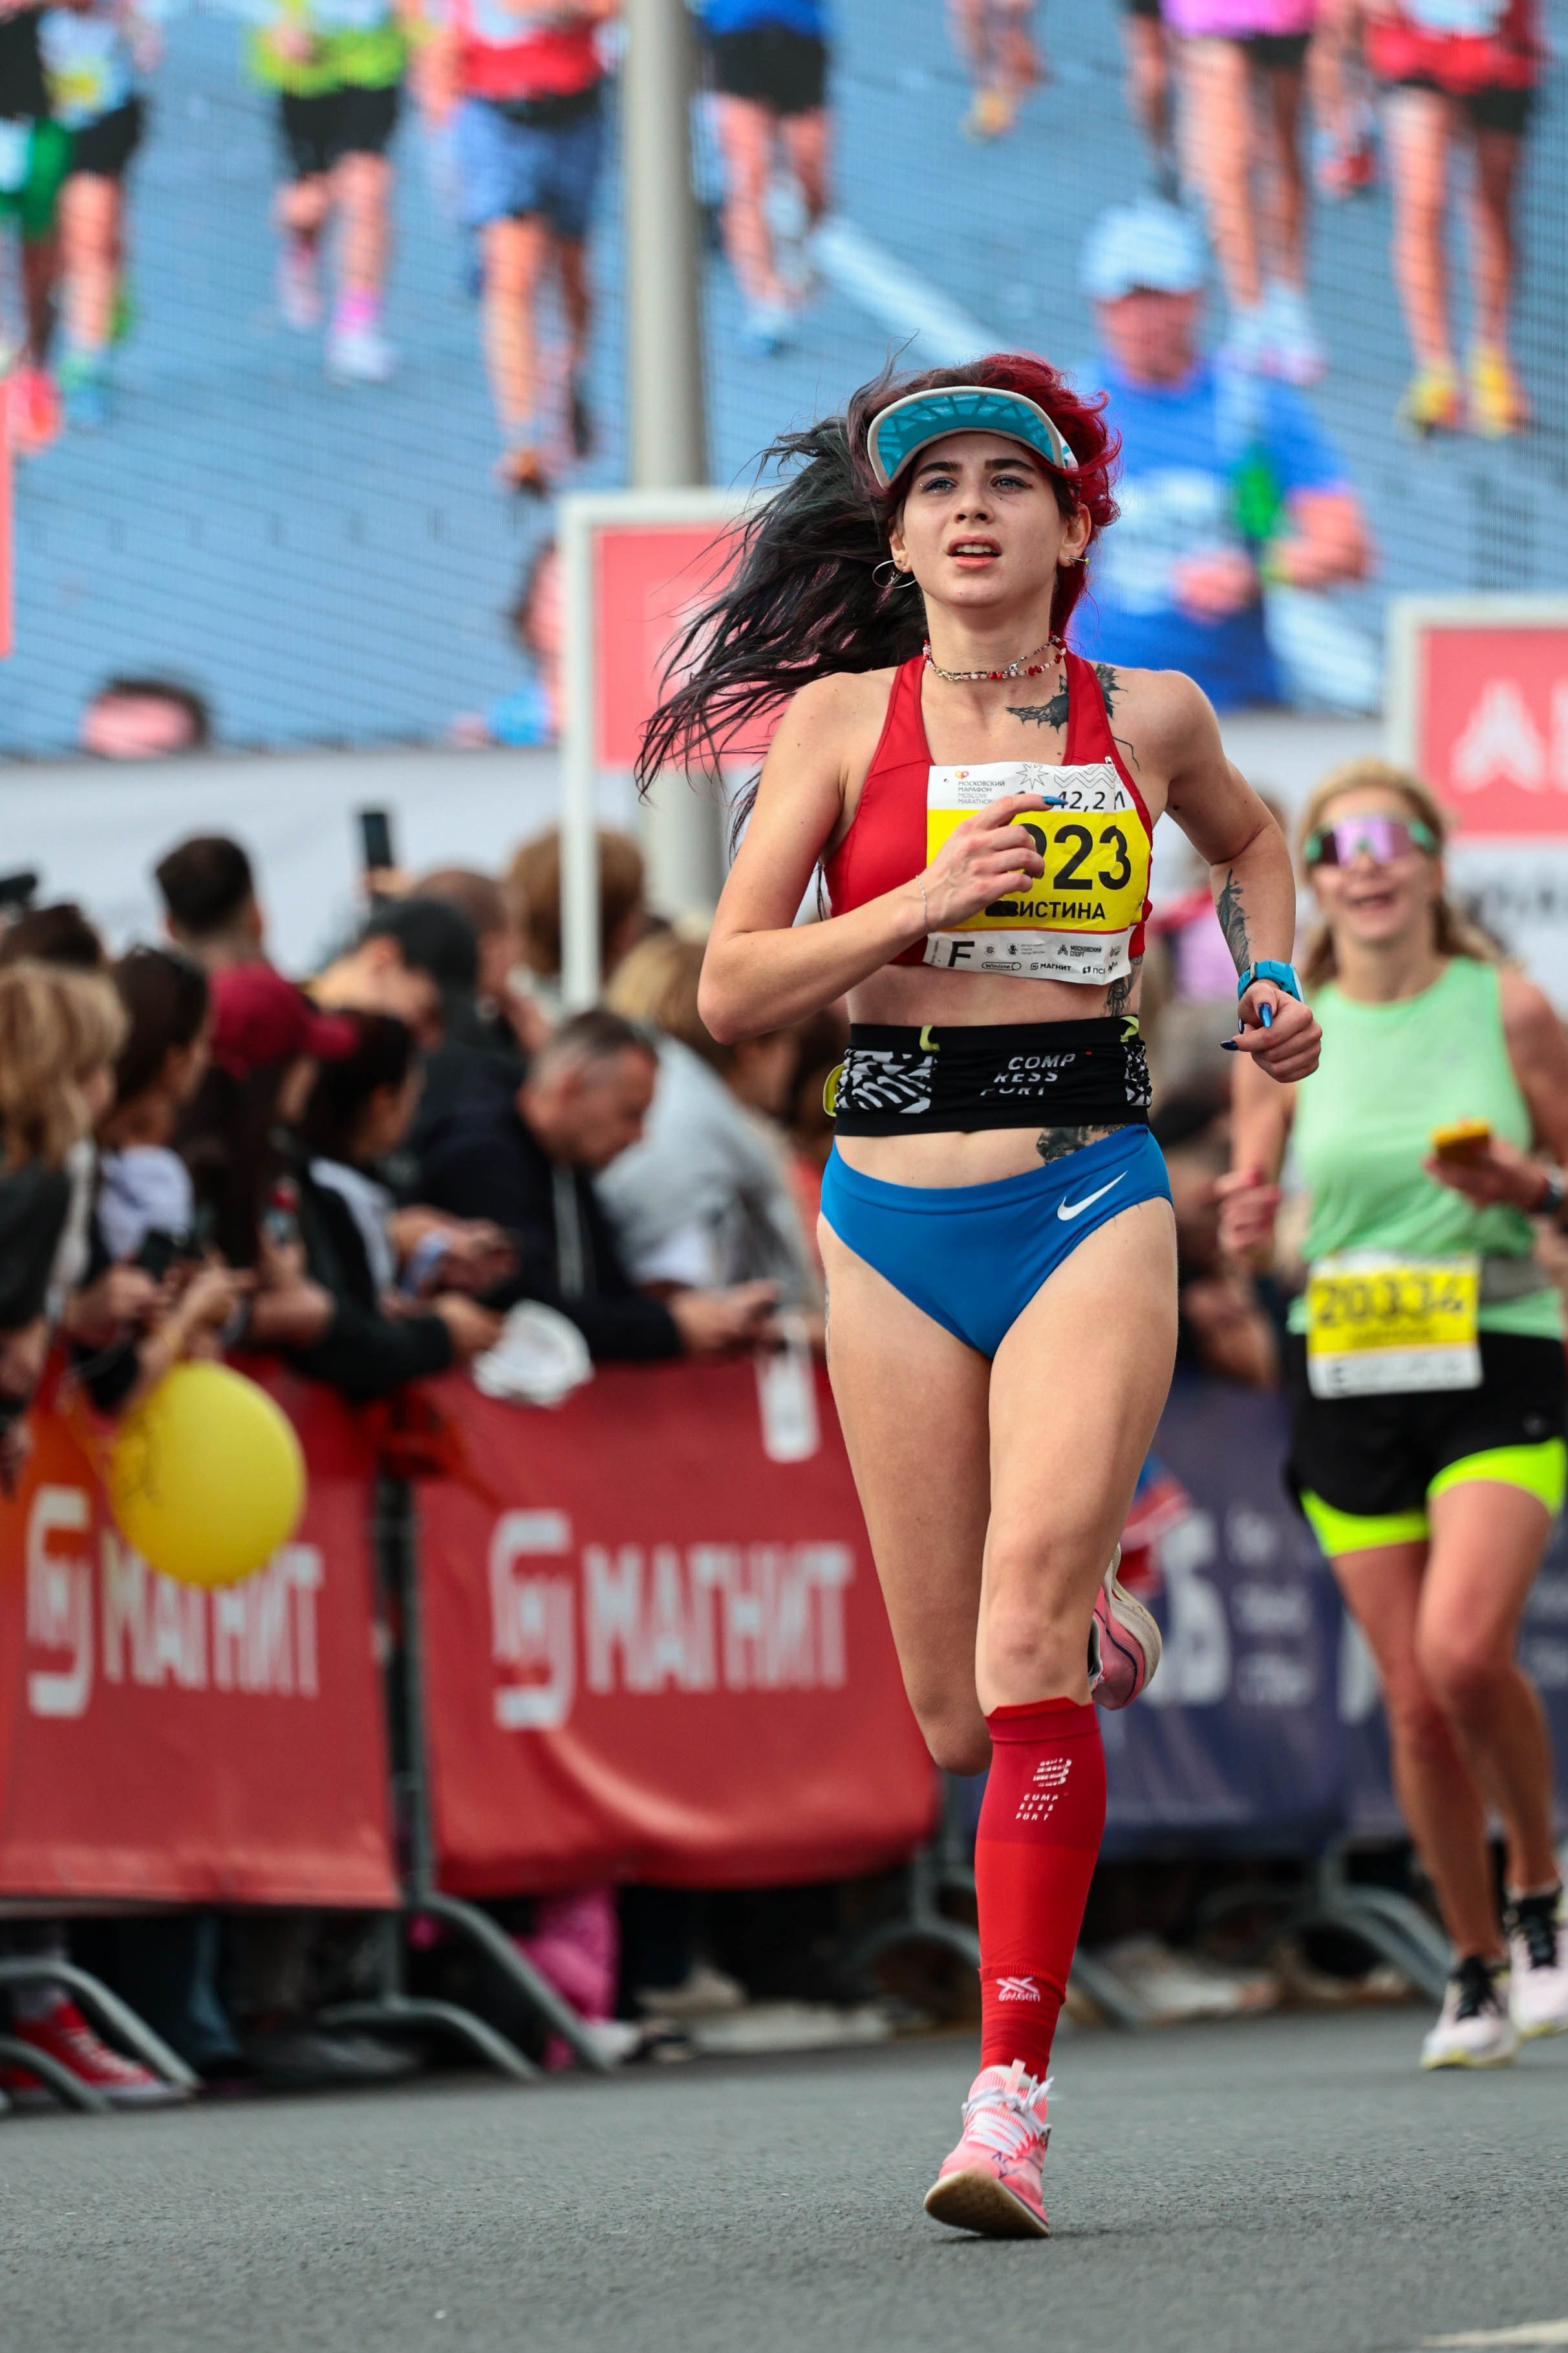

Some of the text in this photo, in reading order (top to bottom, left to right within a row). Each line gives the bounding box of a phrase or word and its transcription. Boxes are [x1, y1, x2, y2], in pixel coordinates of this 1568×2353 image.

[987, 901, 1106, 919] ИСТИНА
[947, 941, 974, 967] F
[1008, 1054, 1075, 1070] COMP
[583, 1542, 852, 1695] МАГНИТ
